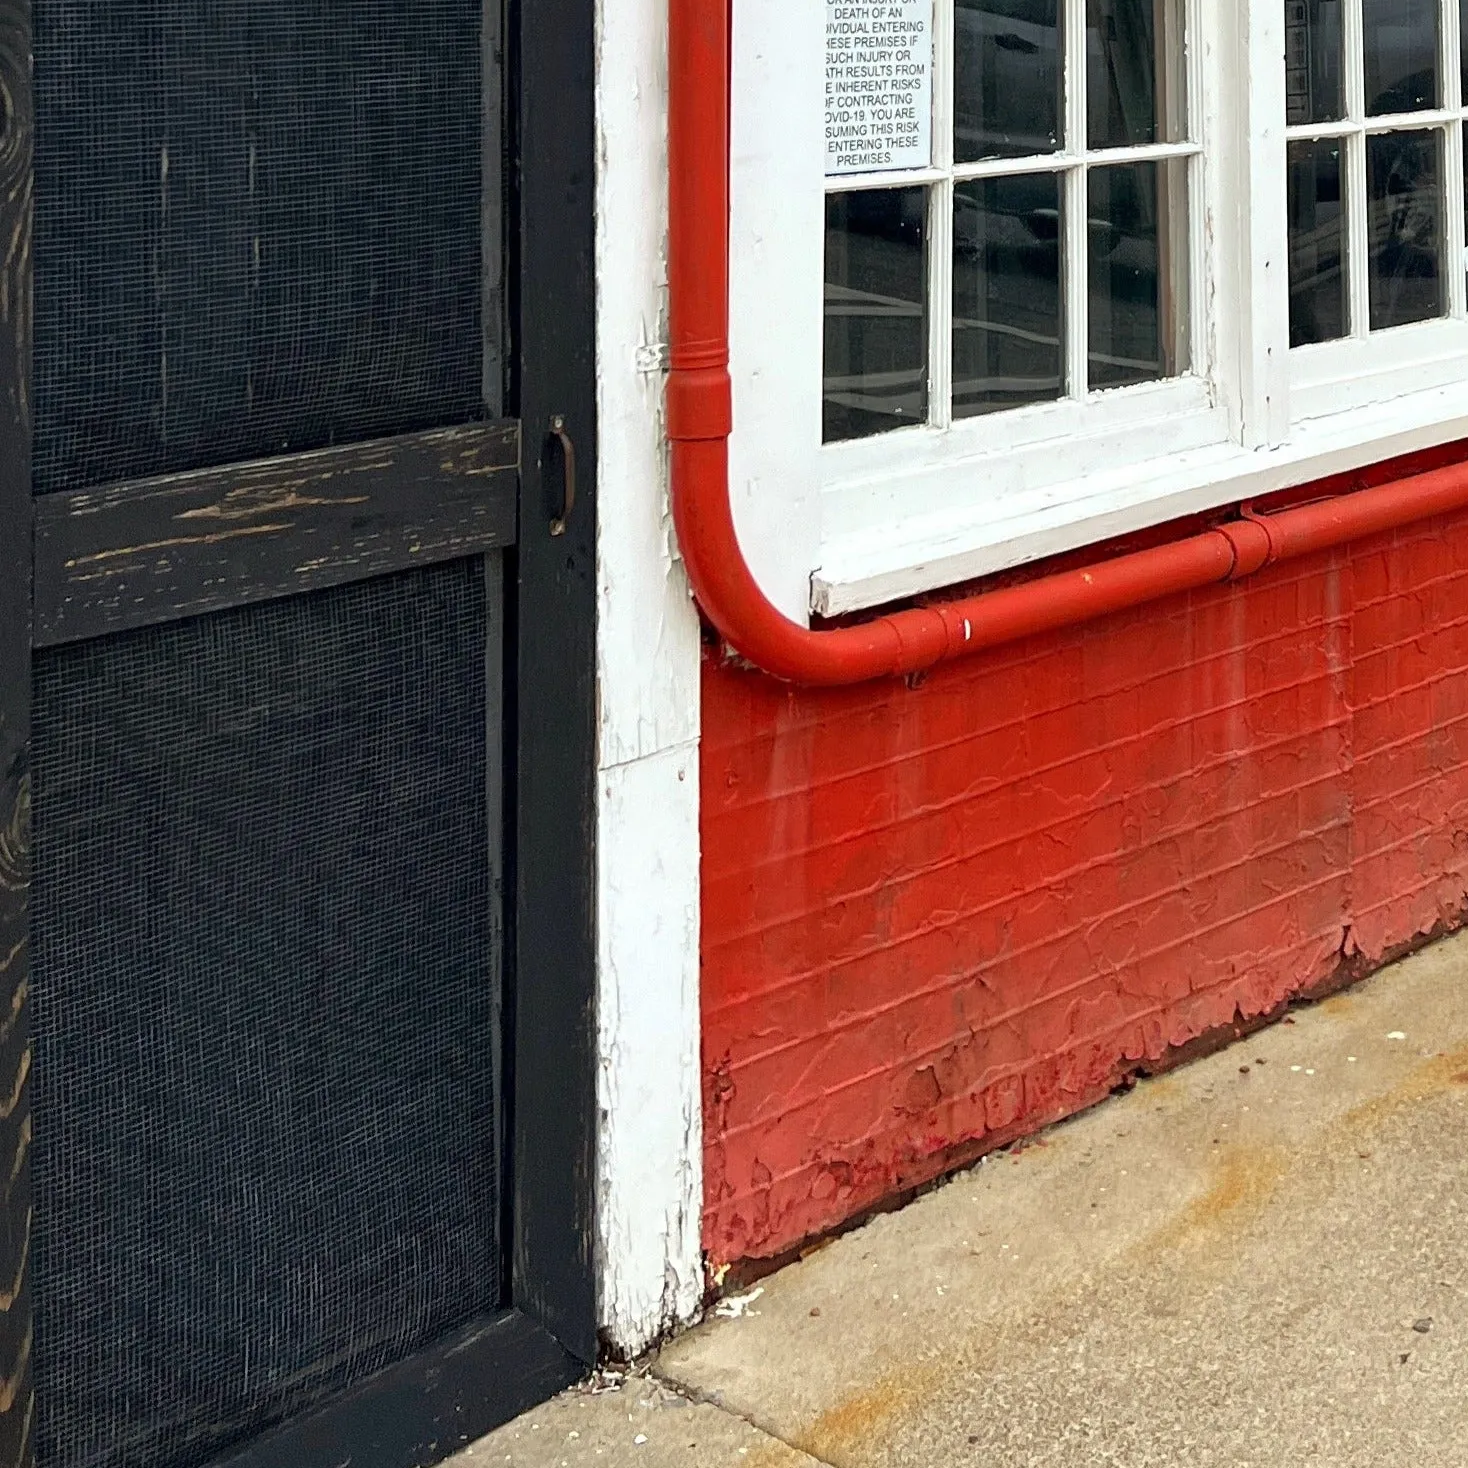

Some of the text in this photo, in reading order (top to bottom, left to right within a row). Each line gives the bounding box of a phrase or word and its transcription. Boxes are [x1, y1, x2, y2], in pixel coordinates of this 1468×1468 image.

[834, 7, 902, 19] DEATH OF AN
[872, 21, 924, 32] ENTERING
[854, 36, 906, 48] PREMISES
[909, 35, 918, 46] IF
[856, 51, 893, 62] INJURY
[896, 50, 911, 61] OR
[846, 65, 892, 77] RESULTS
[896, 64, 924, 75] FROM
[836, 79, 888, 93] INHERENT
[891, 78, 921, 90] RISKS
[837, 93, 912, 107] CONTRACTING
[870, 108, 892, 120] YOU
[895, 107, 915, 119] ARE
[825, 121, 920, 138] SUMING THIS RISK
[828, 136, 918, 152] ENTERING THESE
[837, 152, 893, 166] PREMISES.
